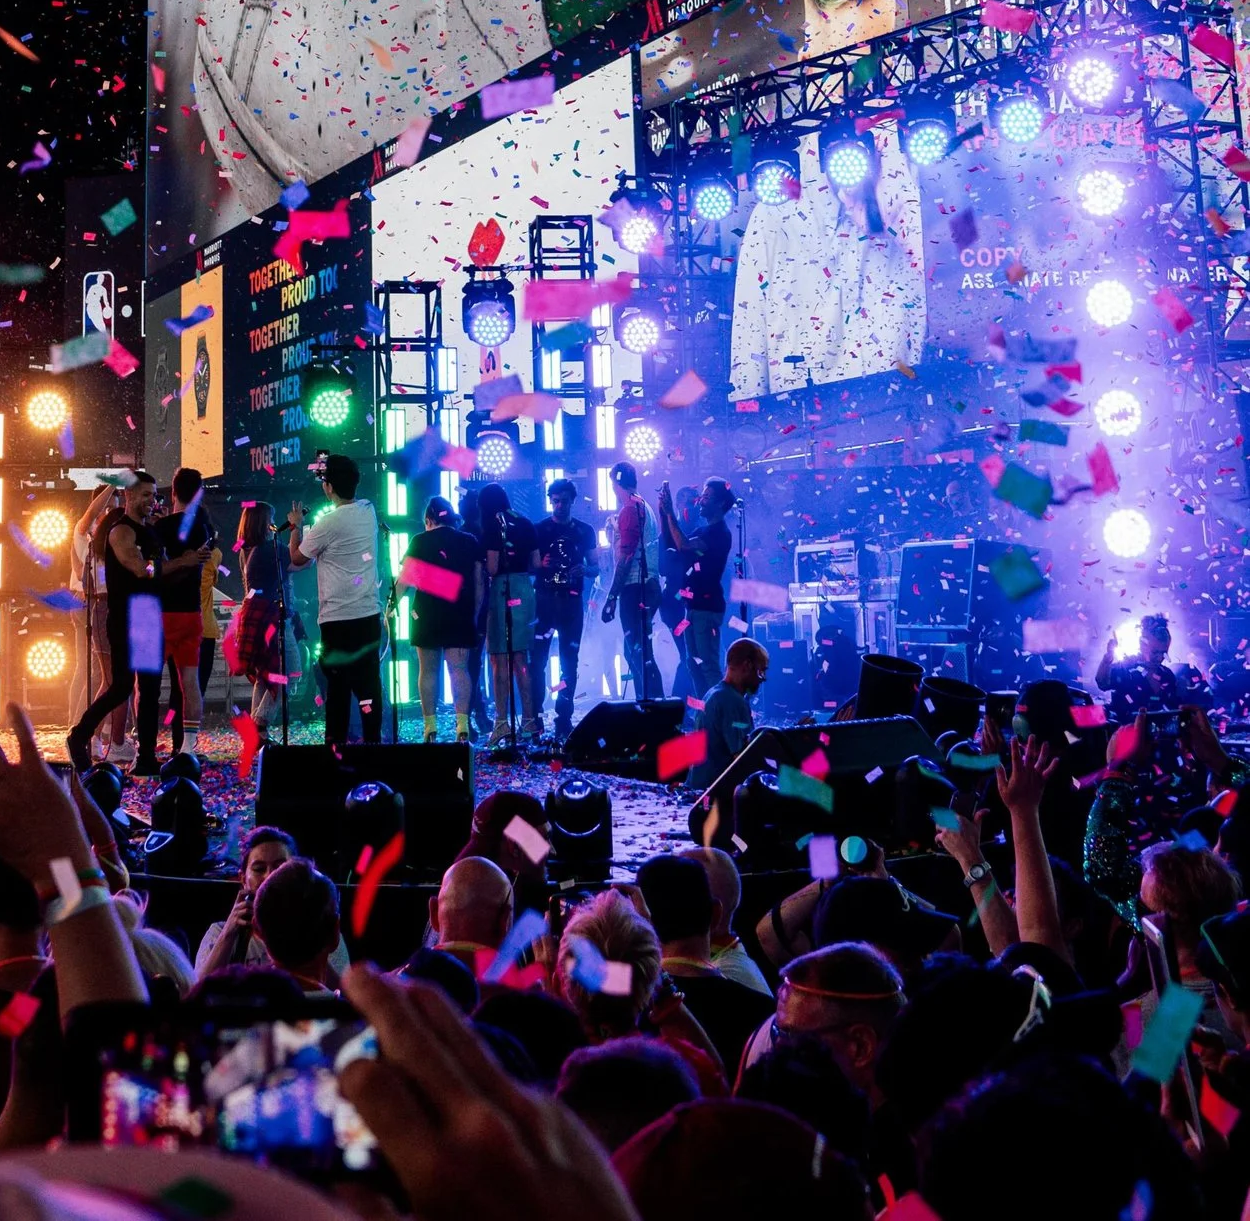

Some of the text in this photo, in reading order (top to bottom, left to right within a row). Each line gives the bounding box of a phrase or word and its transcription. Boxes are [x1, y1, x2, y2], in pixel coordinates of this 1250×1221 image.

[280, 274, 316, 312] PROUD
[249, 312, 300, 354] TOGETHER
[249, 374, 300, 412] TOGETHER
[281, 405, 312, 433] PRO
[250, 436, 301, 472] TOGETHER
